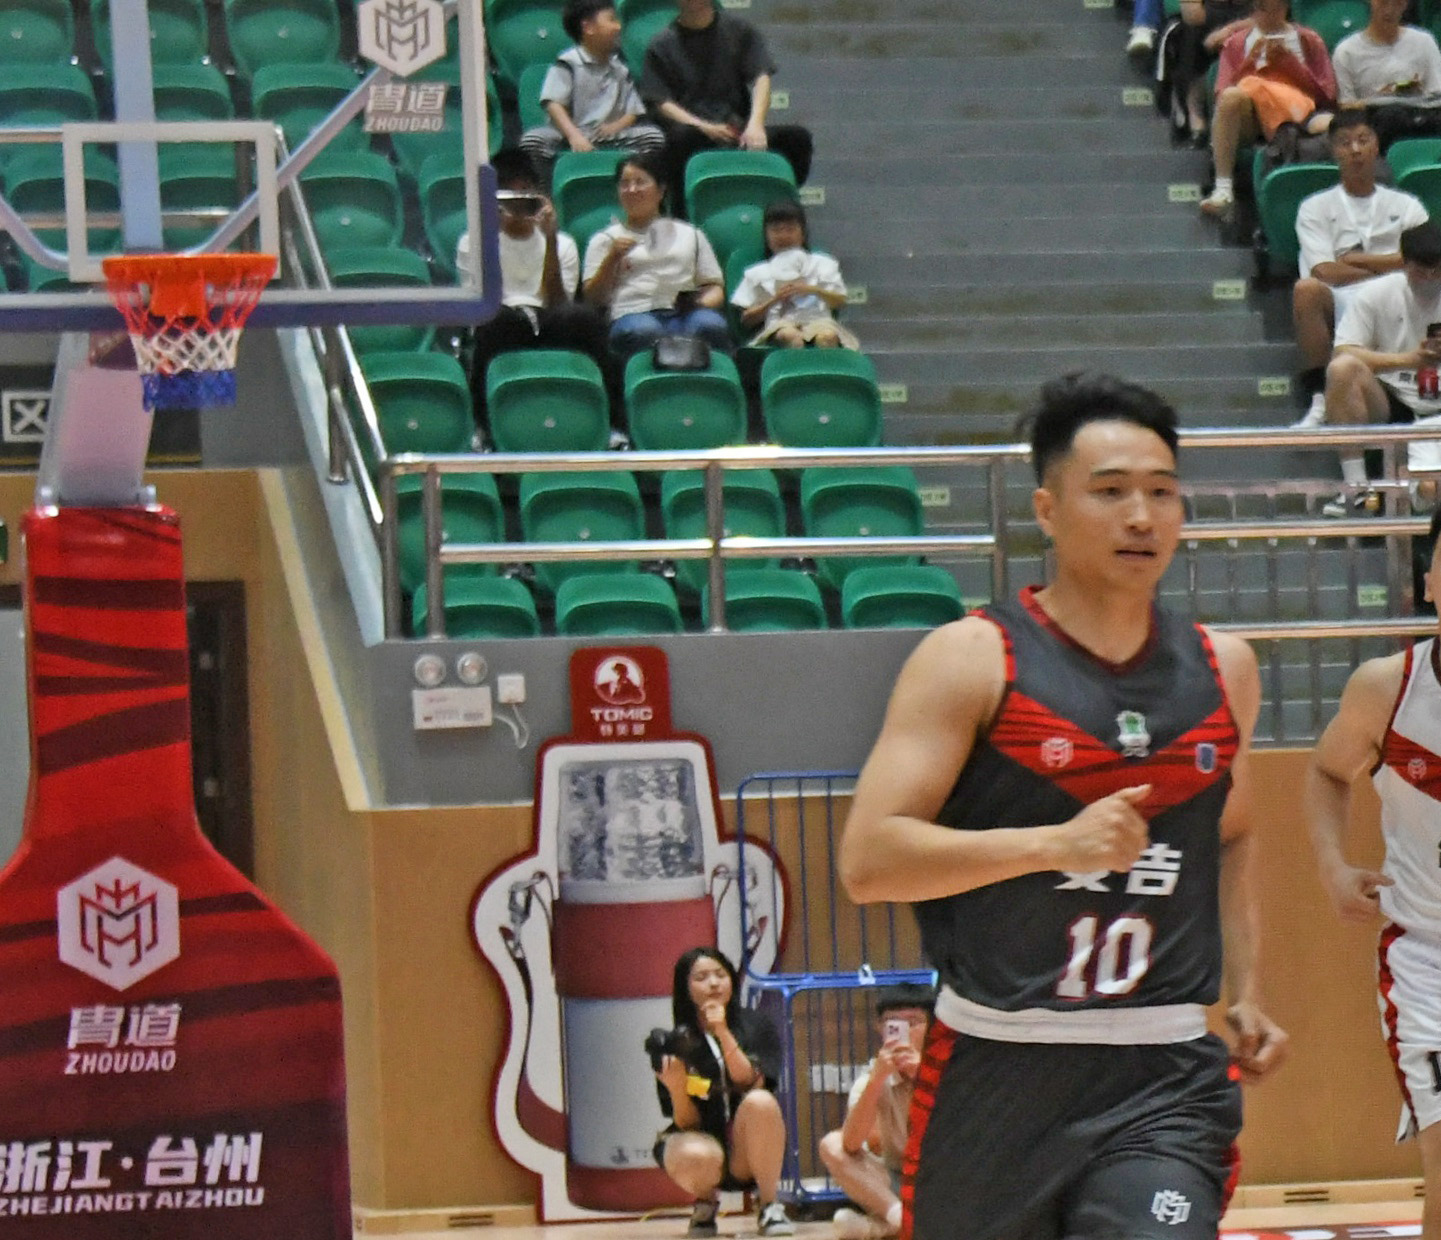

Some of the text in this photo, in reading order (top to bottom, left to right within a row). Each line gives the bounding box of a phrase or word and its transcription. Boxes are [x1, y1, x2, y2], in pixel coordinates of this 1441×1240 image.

[363, 116, 444, 133] ZHOUDAO
[1055, 910, 1155, 1001] 10
[64, 1050, 177, 1075] ZHOUDAO
